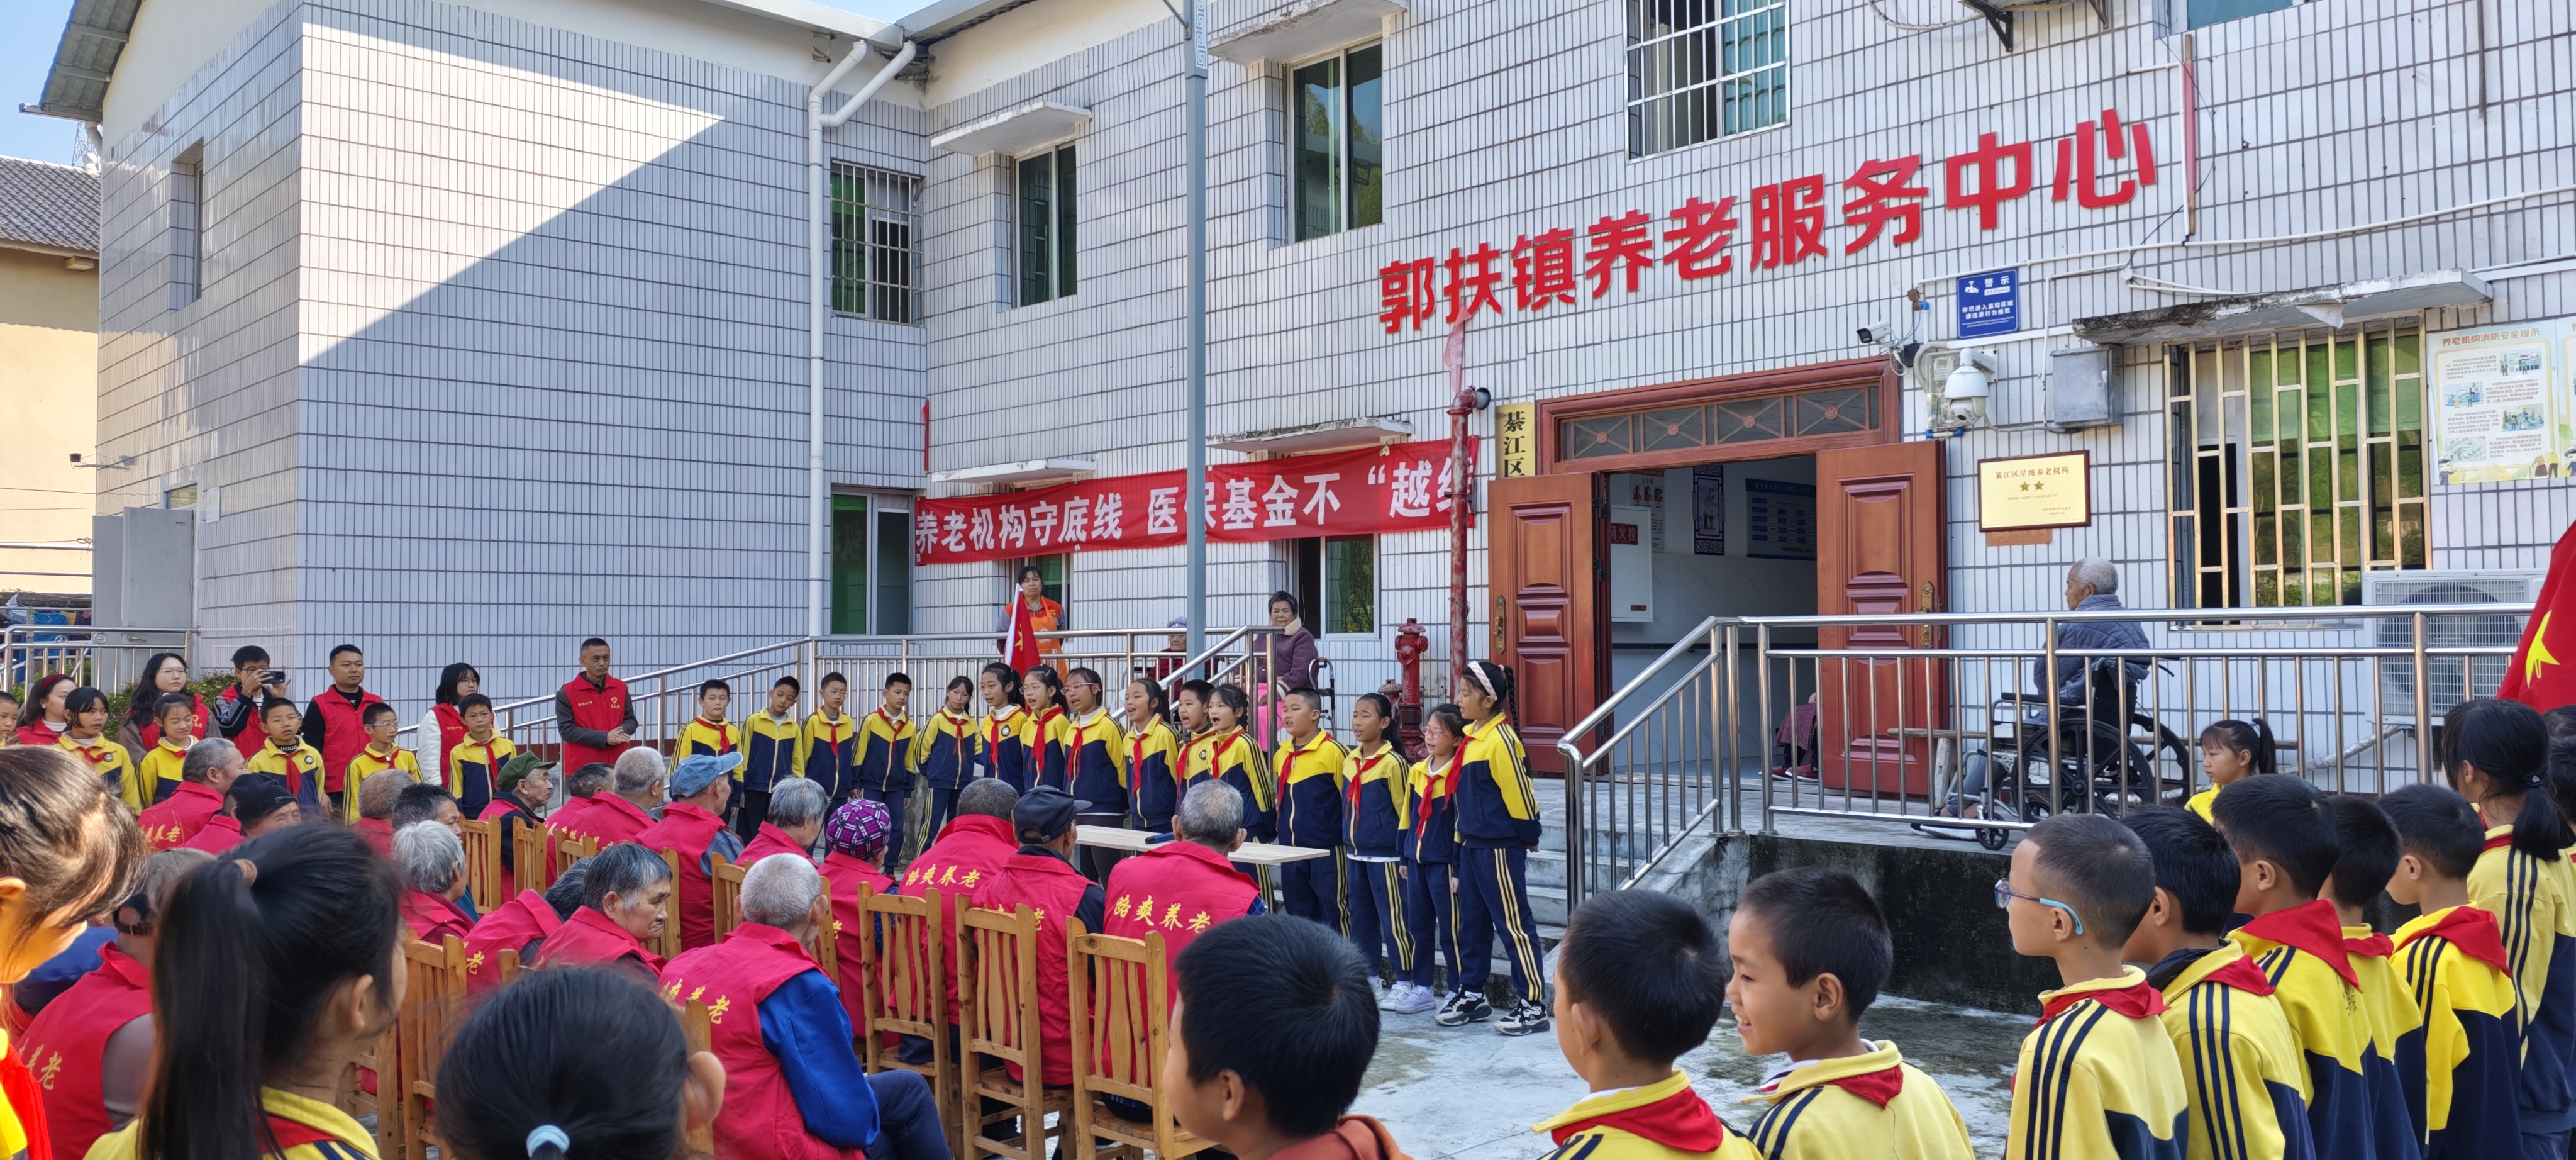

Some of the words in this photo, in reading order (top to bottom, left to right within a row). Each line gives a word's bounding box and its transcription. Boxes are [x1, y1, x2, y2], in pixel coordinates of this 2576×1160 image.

[1379, 108, 2156, 334] 郭扶镇养老服务中心
[1984, 276, 2010, 287] 警示
[2441, 328, 2541, 347] 养老机构消防安全提示
[1503, 411, 1526, 477] 綦江区
[1996, 466, 2069, 479] 綦江区星级养老机构
[915, 493, 1123, 554] 养老机构守底线
